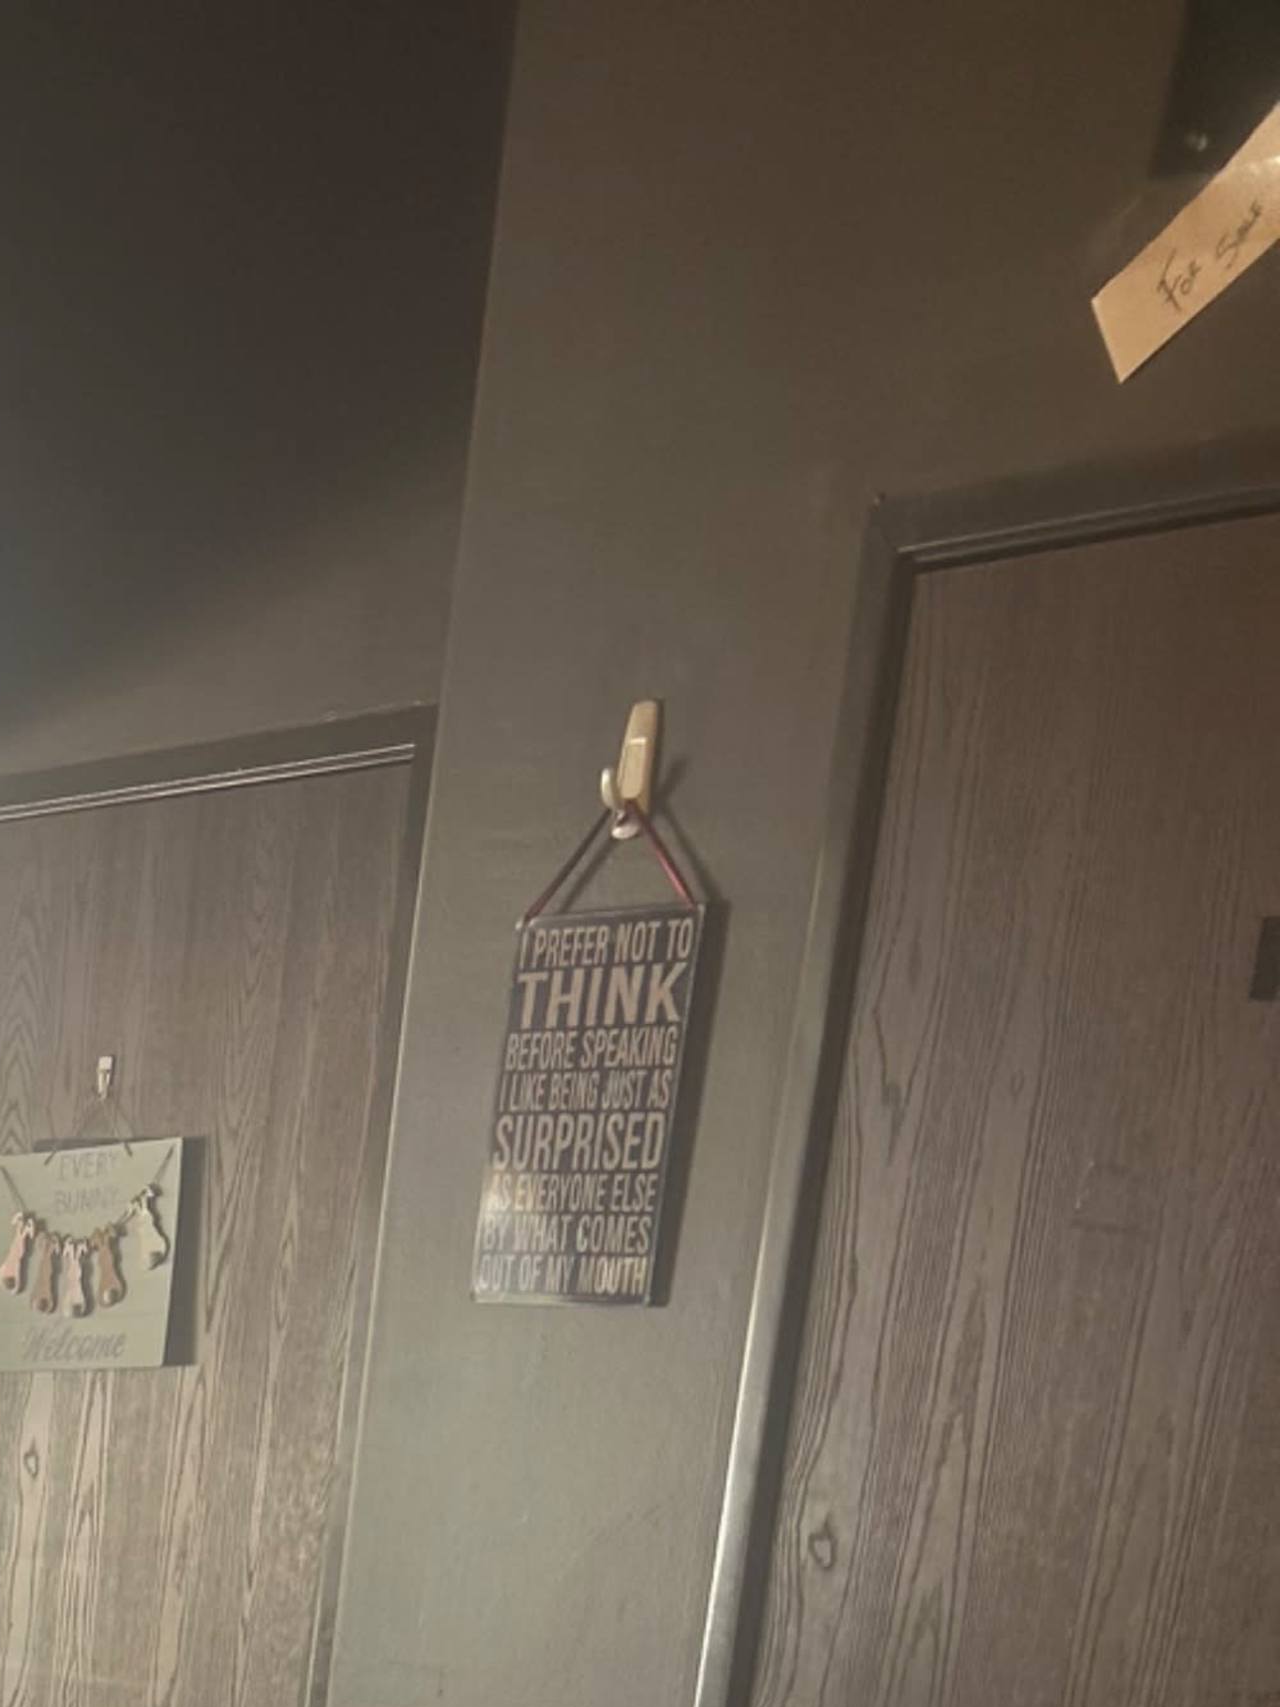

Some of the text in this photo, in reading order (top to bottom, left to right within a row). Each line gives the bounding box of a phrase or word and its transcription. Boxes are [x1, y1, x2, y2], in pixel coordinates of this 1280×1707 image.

[519, 918, 694, 970] I PREFER NOT TO
[516, 961, 688, 1029] THINK
[504, 1025, 678, 1071] BEFORE SPEAKING
[499, 1068, 673, 1112] I LIKE BEING JUST AS
[492, 1111, 666, 1171] SURPRISED
[486, 1172, 659, 1212] AS EVERYONE ELSE
[483, 1213, 653, 1253] BY WHAT COMES
[477, 1254, 649, 1295] OUT OF MY MOUTH
[20, 1326, 127, 1364] Welcome
